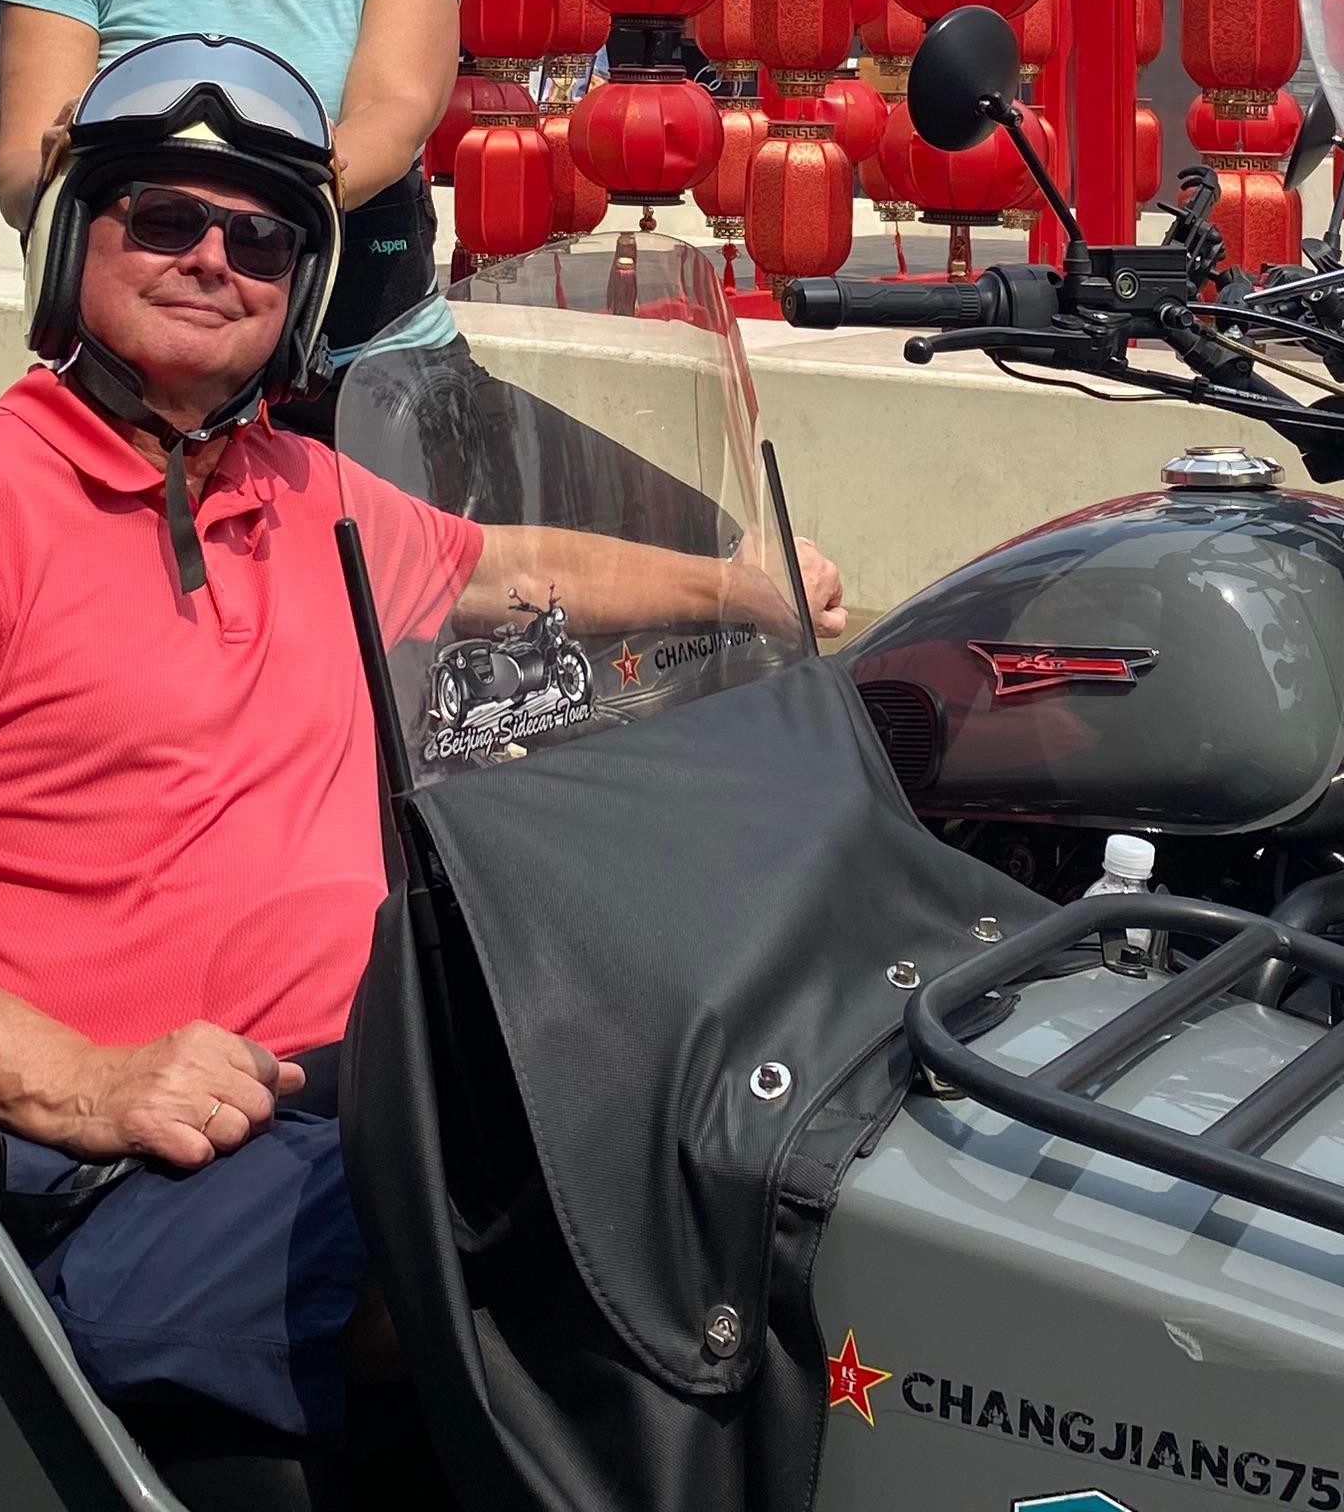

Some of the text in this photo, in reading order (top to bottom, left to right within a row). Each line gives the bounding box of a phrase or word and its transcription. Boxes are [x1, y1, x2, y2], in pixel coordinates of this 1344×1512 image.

[369, 238, 408, 255] Aspen
[436, 697, 592, 761] Beijing Sidecar Tour
